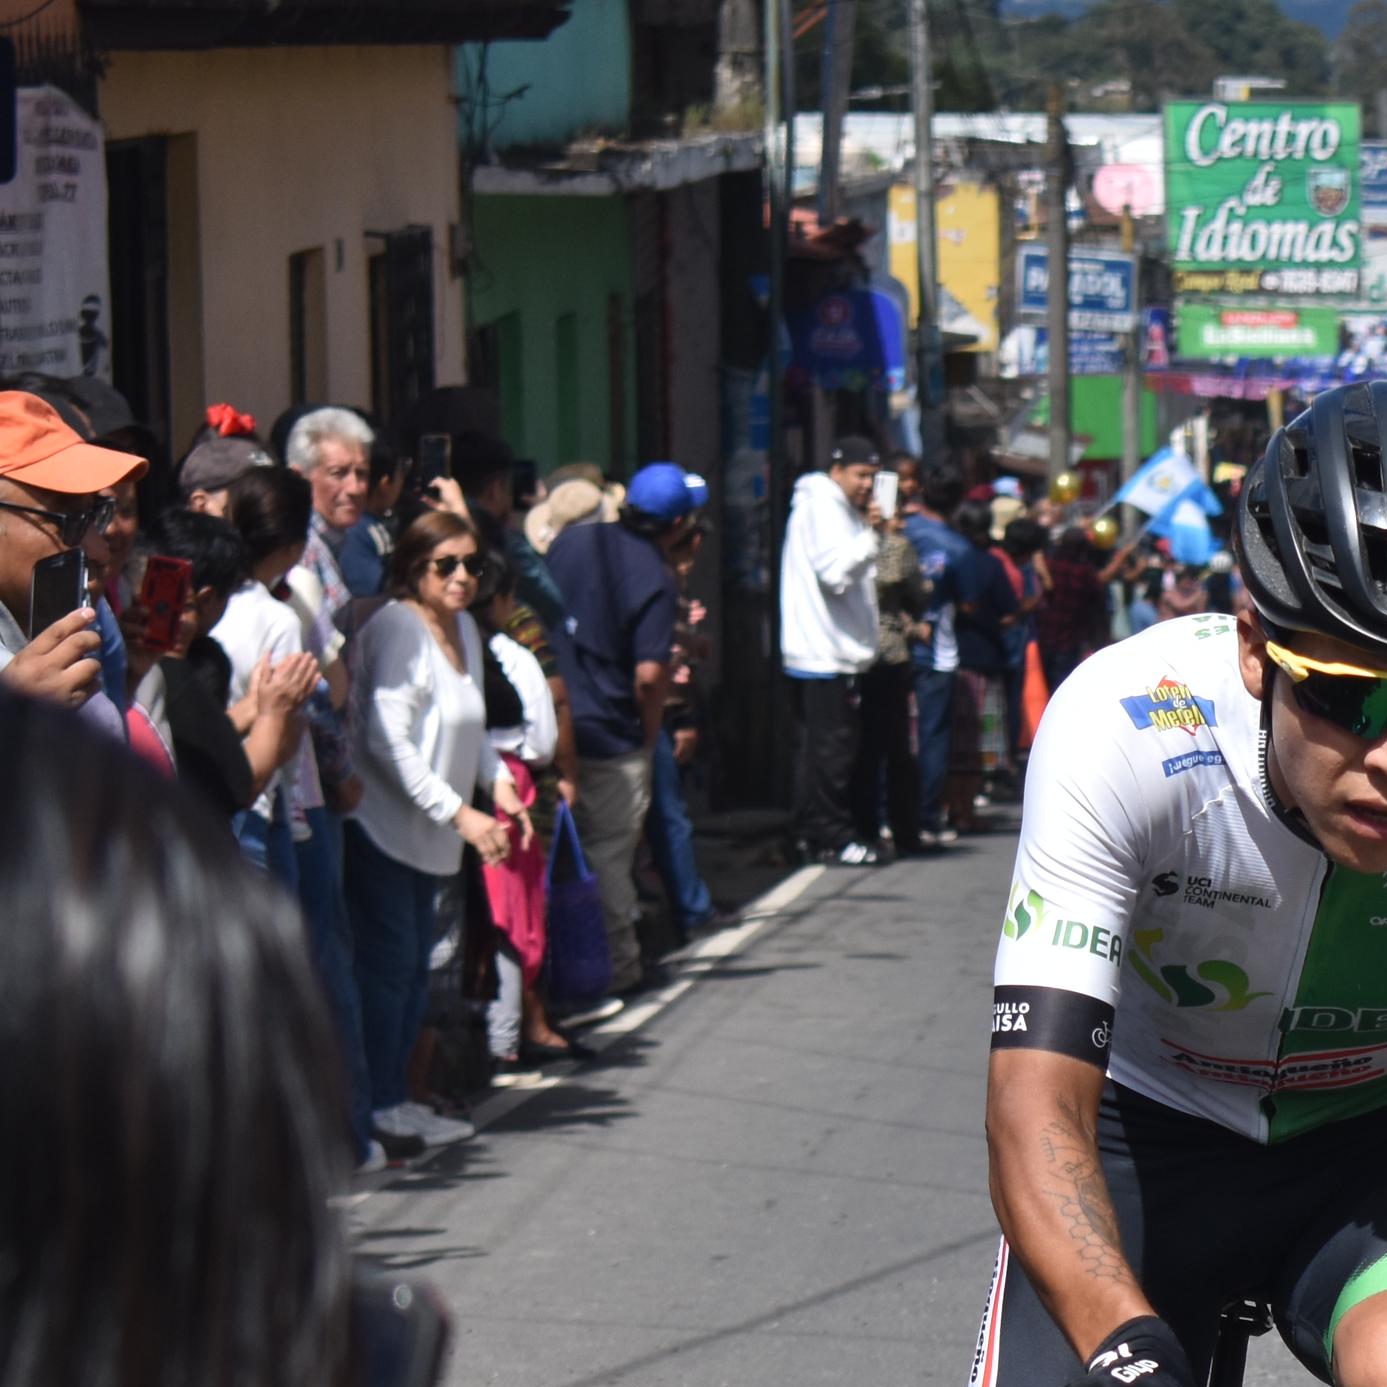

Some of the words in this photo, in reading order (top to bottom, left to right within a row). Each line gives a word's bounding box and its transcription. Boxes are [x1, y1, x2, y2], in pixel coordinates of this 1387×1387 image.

[1185, 104, 1341, 166] Centro
[1243, 161, 1282, 206] de
[1174, 197, 1360, 263] Idiomas
[1183, 895, 1216, 910] TEAM
[1184, 886, 1273, 909] CONTINENTAL
[1186, 876, 1213, 888] UCI
[1051, 919, 1122, 967] IDEA
